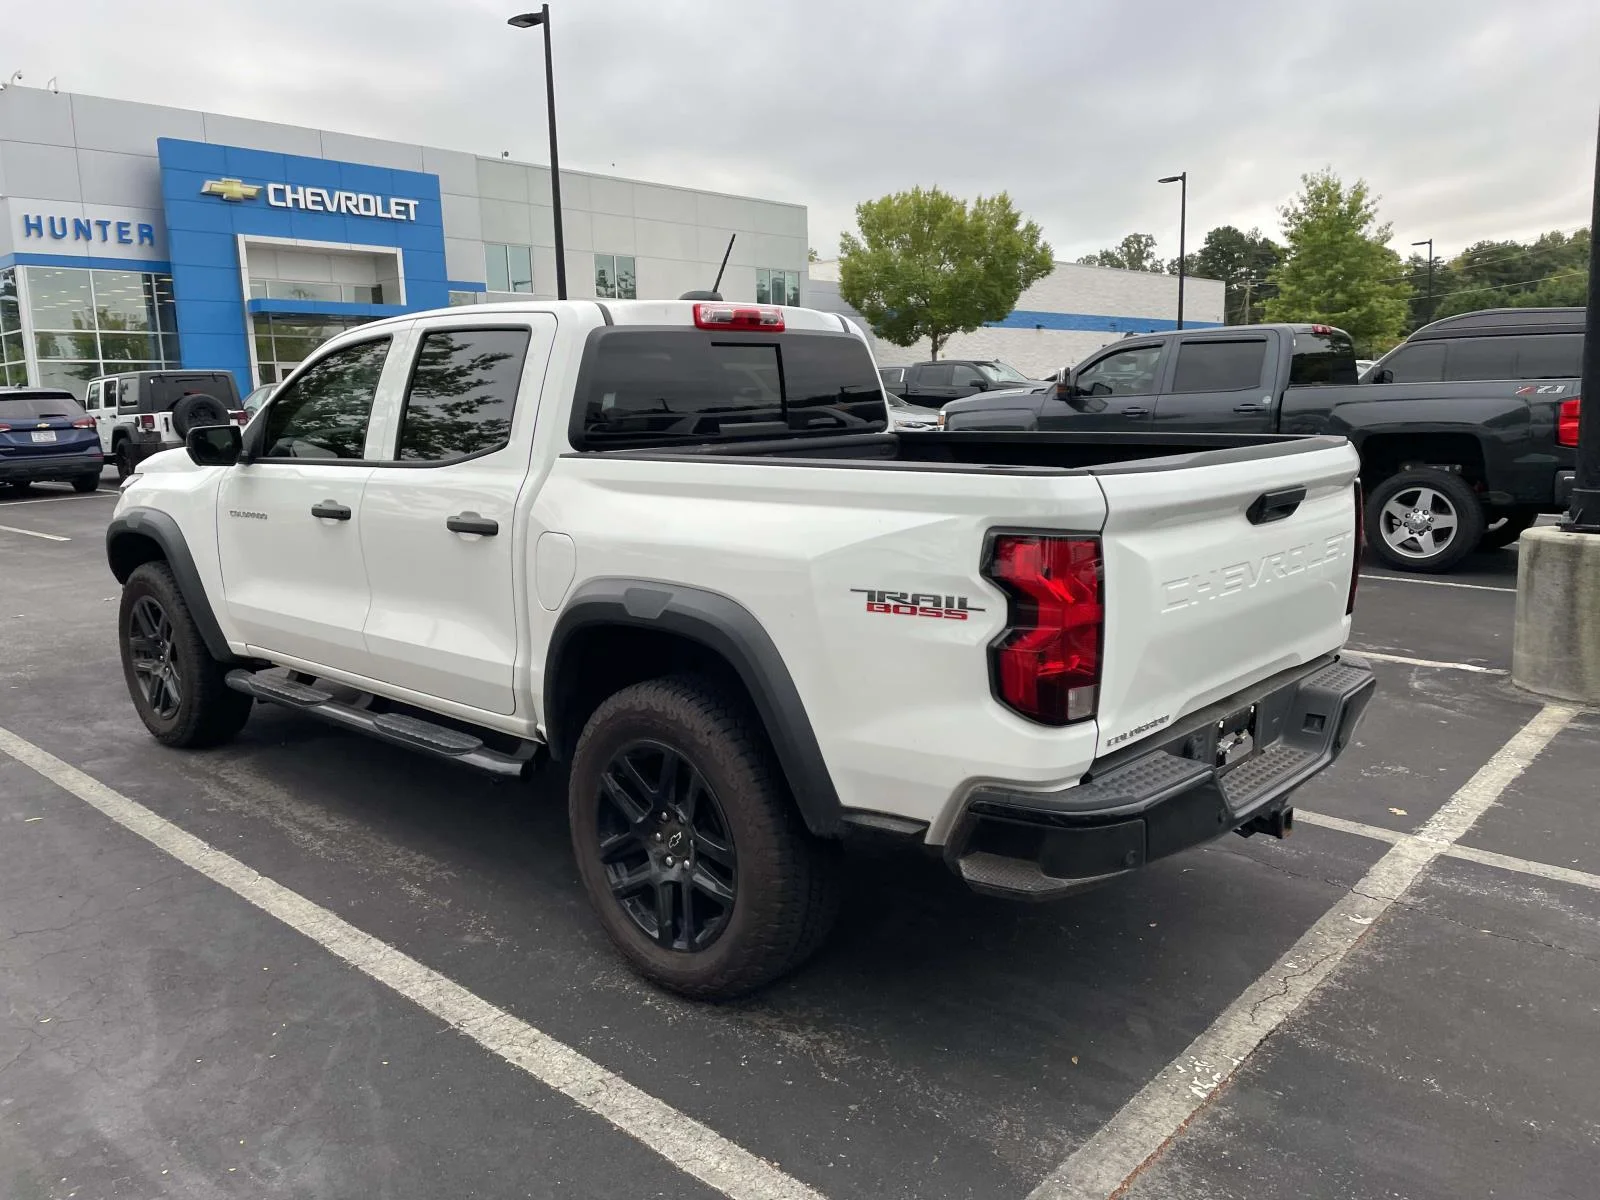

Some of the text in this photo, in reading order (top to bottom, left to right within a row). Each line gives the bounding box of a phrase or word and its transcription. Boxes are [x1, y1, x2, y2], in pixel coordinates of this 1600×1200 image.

[267, 183, 419, 221] CHEVROLET
[23, 214, 155, 246] HUNTER
[850, 588, 986, 612] TRAIL
[866, 602, 968, 620] BOSS
